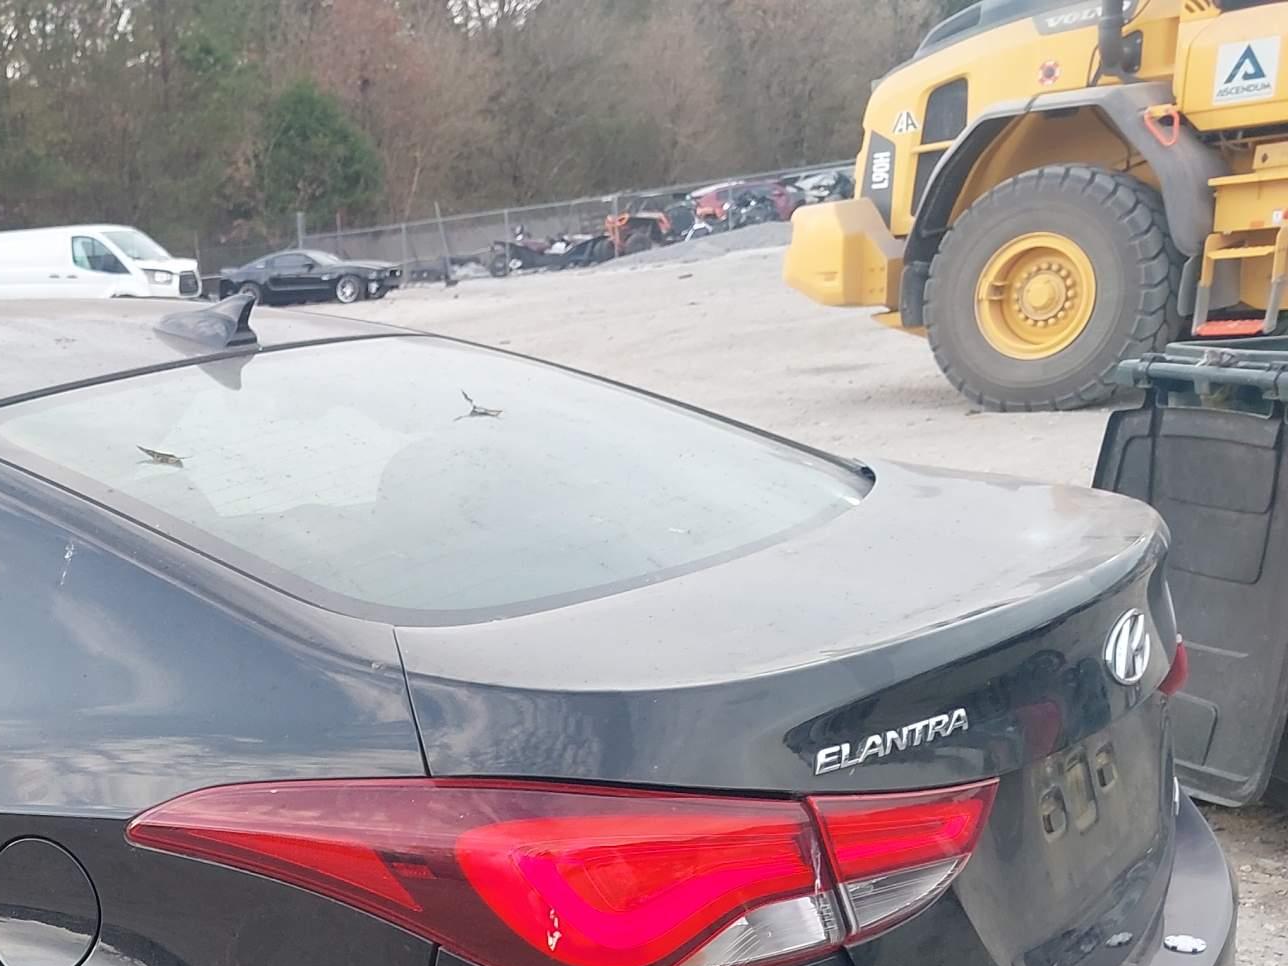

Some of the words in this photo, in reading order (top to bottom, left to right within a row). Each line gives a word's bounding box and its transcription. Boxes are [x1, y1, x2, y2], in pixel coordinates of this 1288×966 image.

[1215, 82, 1271, 97] ASCENDUM
[871, 151, 891, 190] L90H
[815, 707, 969, 776] ELANTRA
